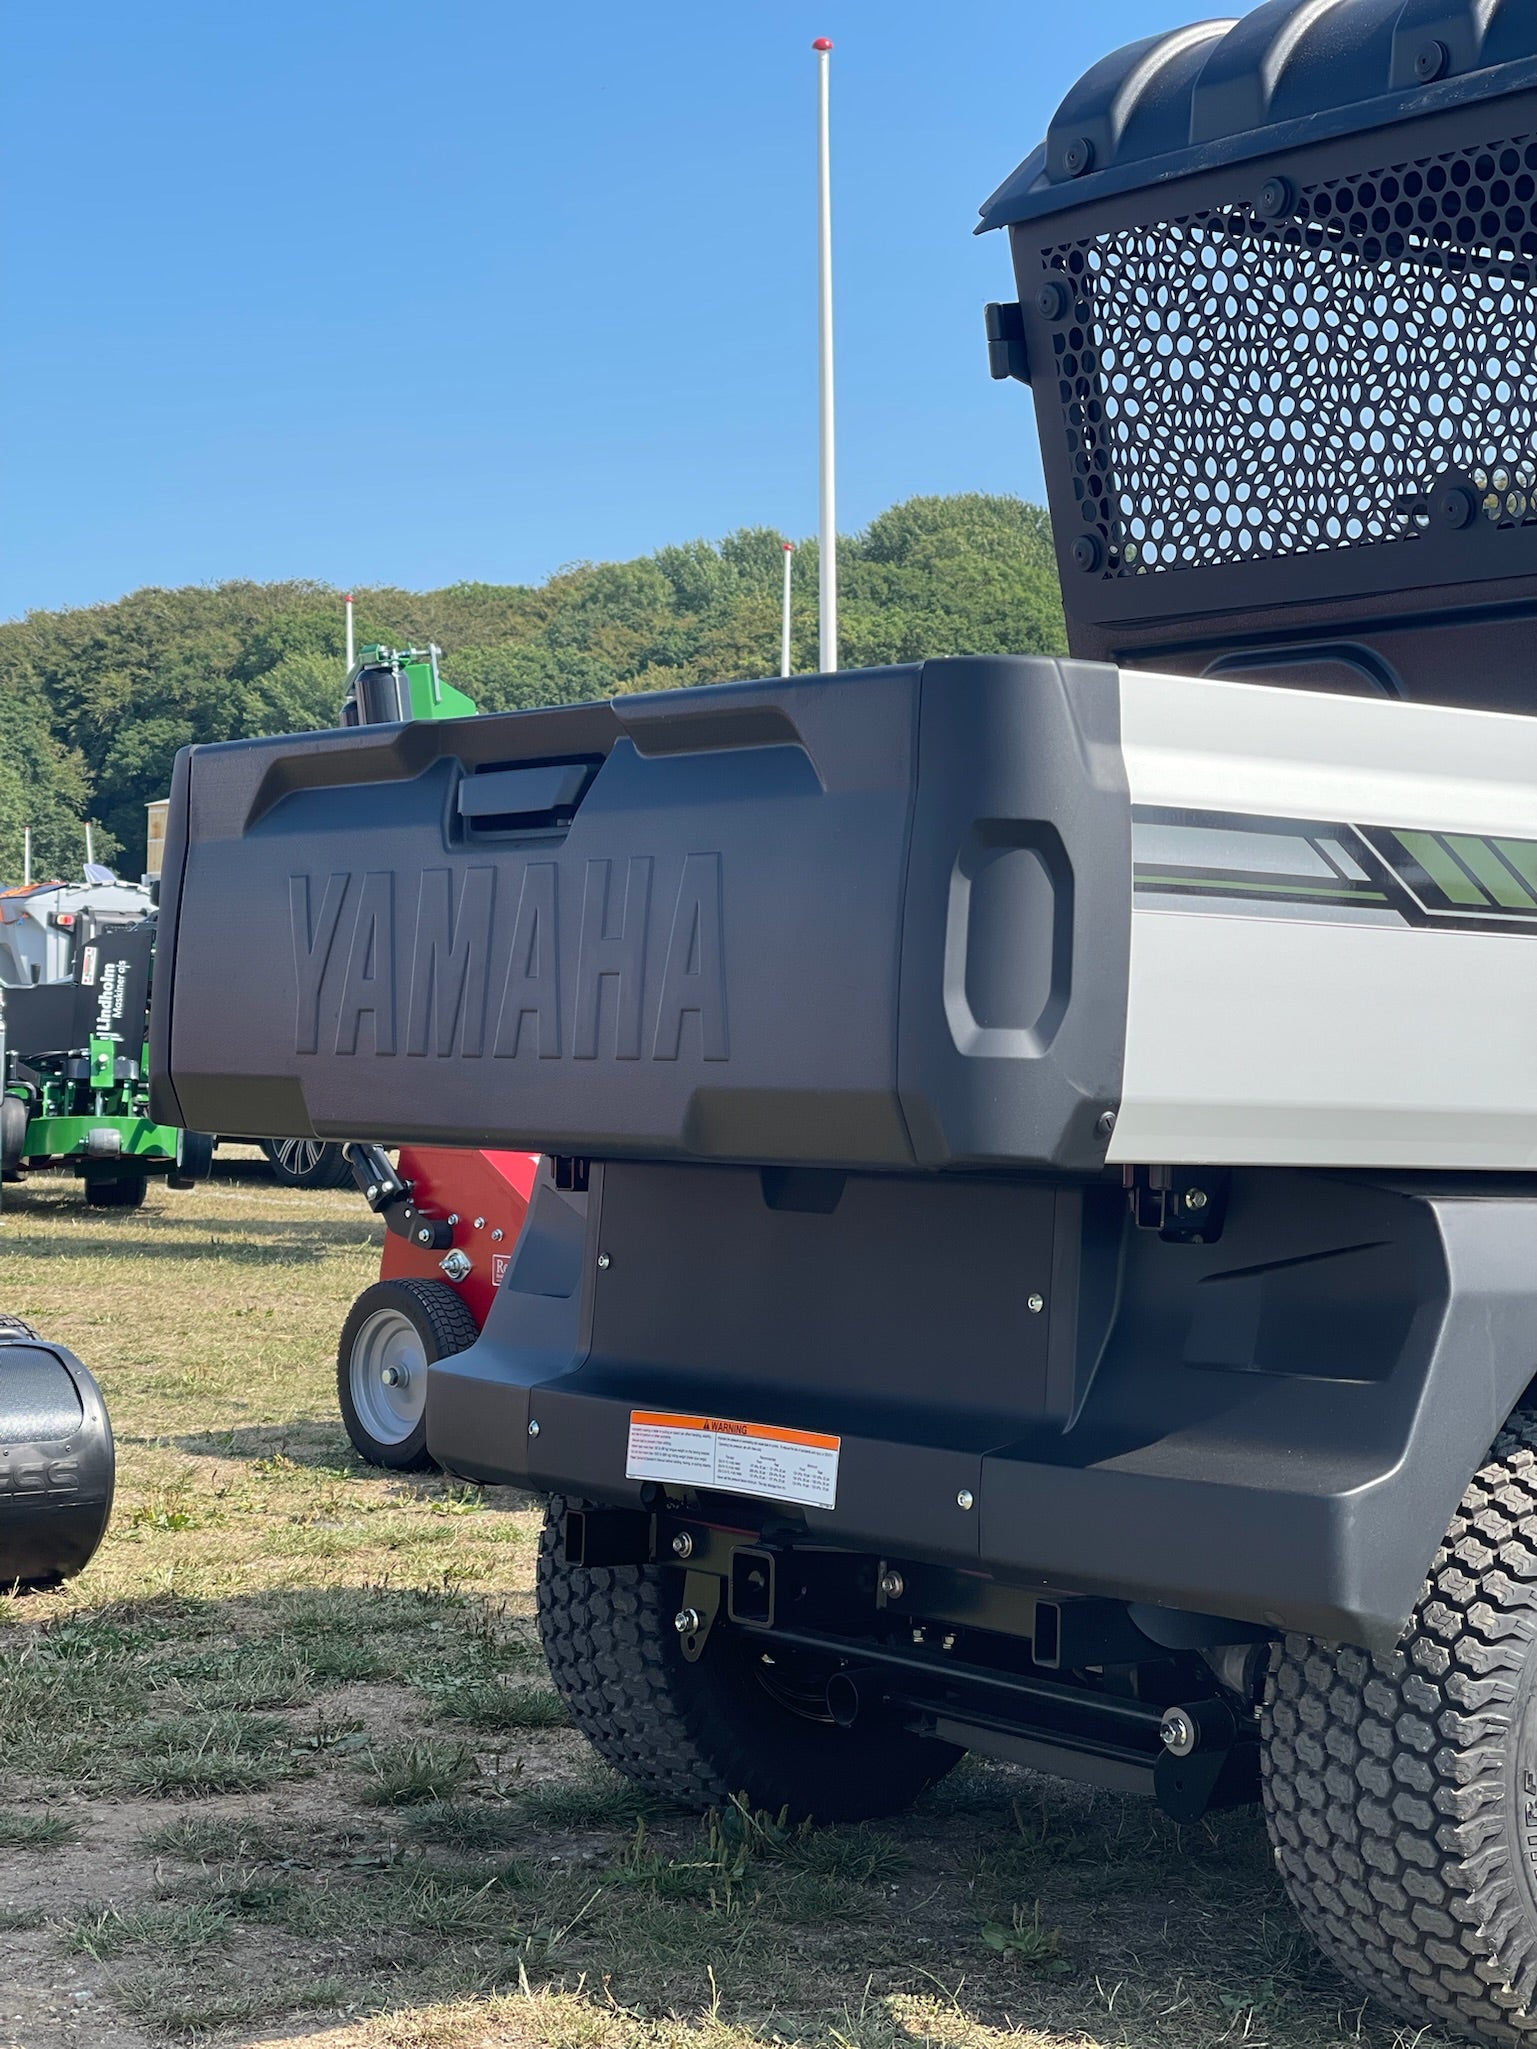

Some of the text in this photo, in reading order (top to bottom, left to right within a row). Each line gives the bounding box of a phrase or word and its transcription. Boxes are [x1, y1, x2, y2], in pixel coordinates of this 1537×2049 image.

[288, 851, 730, 1062] YAMAHA
[96, 963, 115, 1032] Lindholm
[112, 974, 125, 1018] Maskiner
[711, 1420, 748, 1435] WARNING
